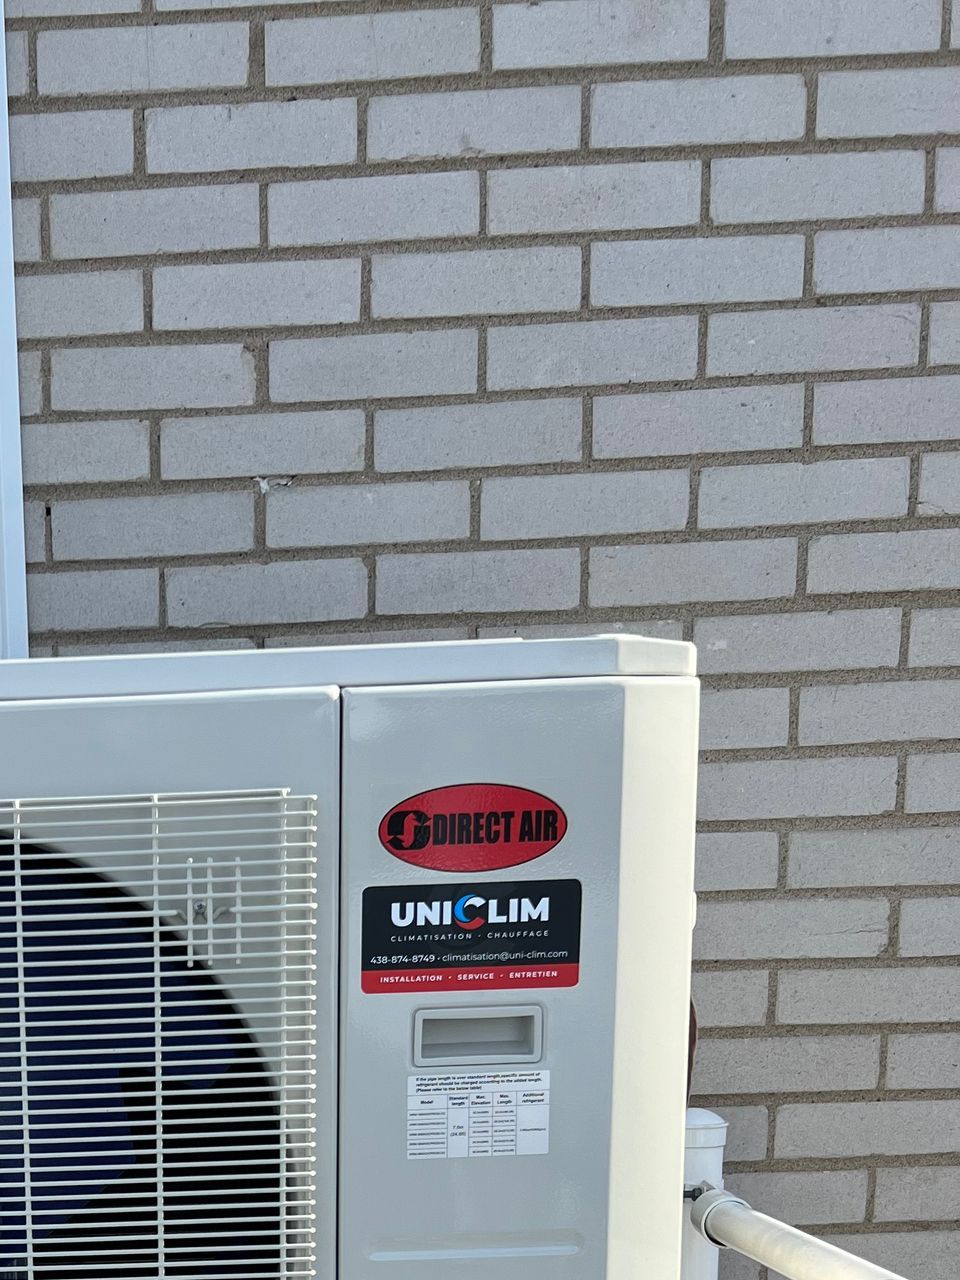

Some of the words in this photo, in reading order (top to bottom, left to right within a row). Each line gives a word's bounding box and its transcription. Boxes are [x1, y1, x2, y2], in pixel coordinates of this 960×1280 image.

[432, 811, 516, 847] DIRECT
[518, 809, 558, 843] AIR
[390, 893, 550, 930] UNICLIM
[390, 932, 473, 943] CLIMATISATION
[487, 929, 550, 940] CHAUFFAGE
[369, 953, 436, 965] 438-874-8749
[441, 950, 568, 963] climatisation@uni-clim.com
[379, 974, 443, 984] INSTALLATION
[457, 972, 495, 981] SERVICE
[509, 970, 559, 979] ENTRETIEN
